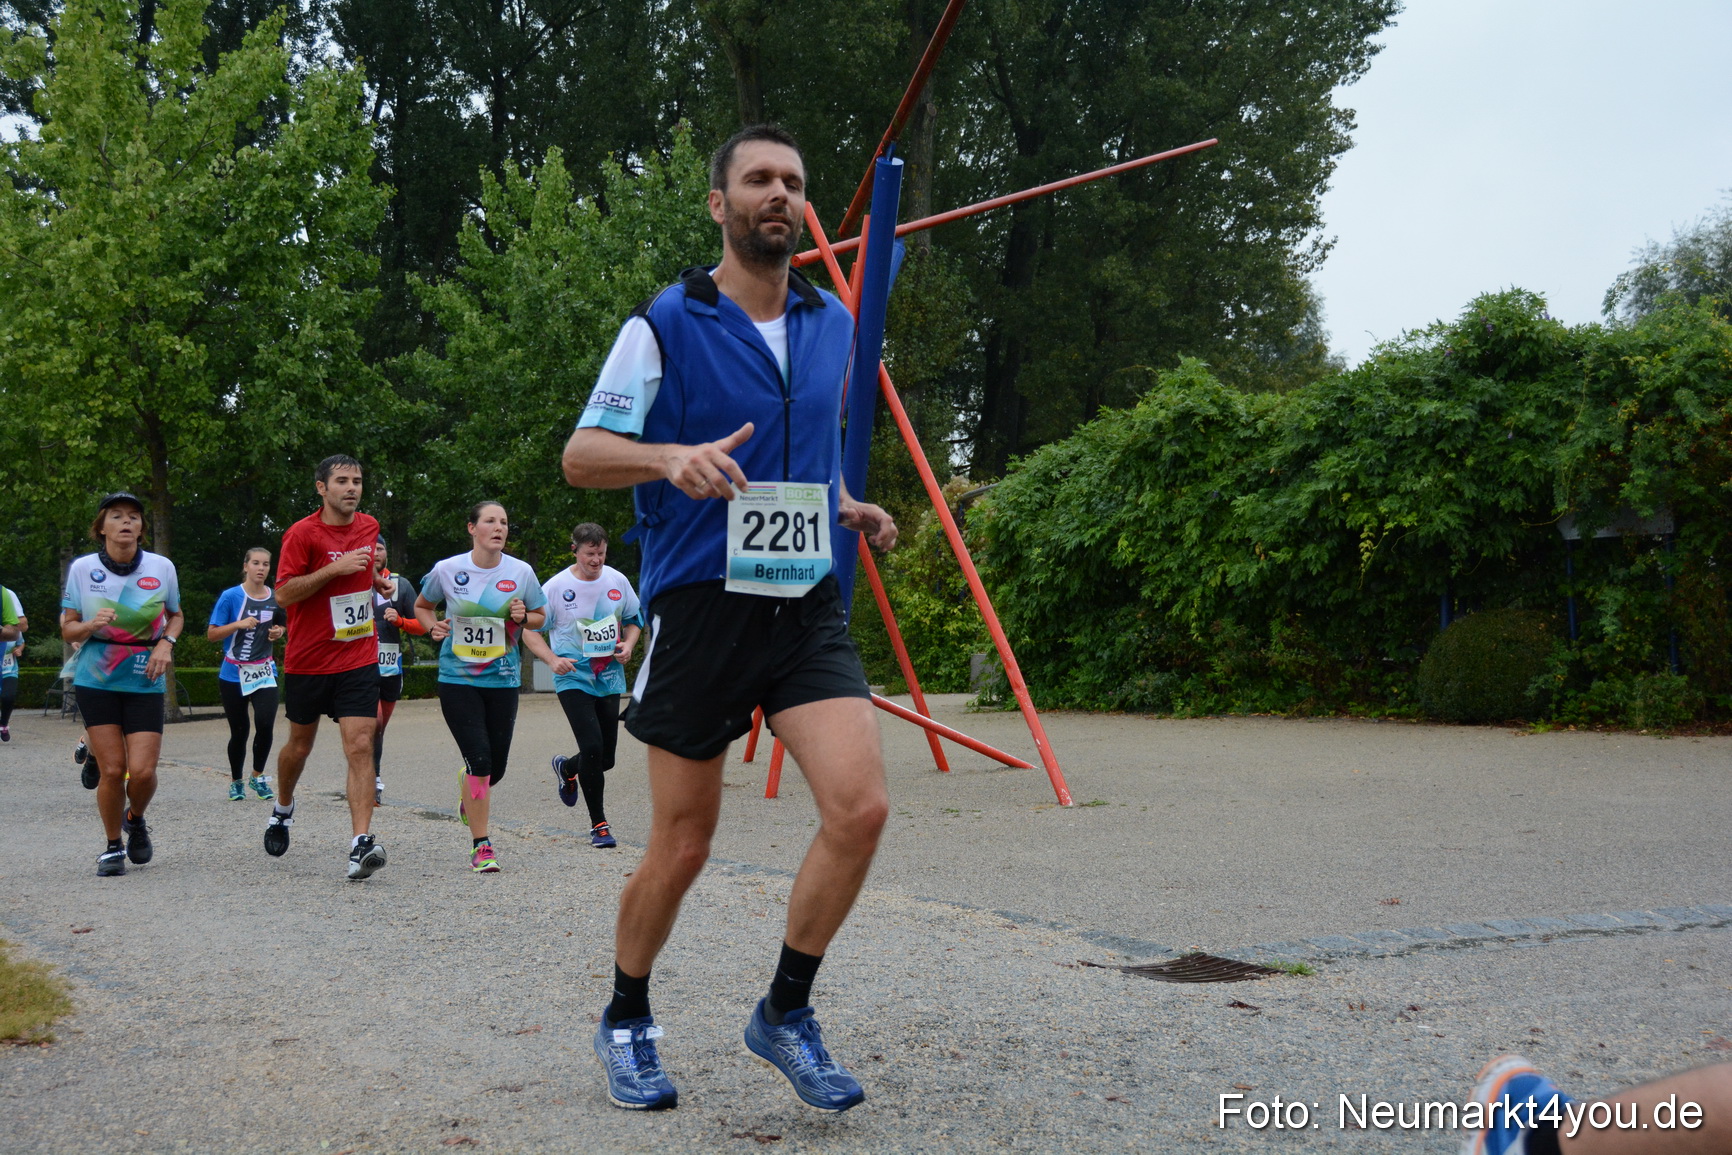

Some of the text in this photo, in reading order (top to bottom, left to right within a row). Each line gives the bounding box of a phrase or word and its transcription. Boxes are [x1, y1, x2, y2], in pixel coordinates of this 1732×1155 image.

[785, 487, 823, 501] BOCK
[742, 510, 820, 552] 2281
[755, 564, 815, 580] Bernhard
[463, 627, 493, 644] 341
[584, 624, 616, 642] 2555
[135, 655, 148, 664] 17.
[379, 651, 397, 665] 039
[471, 648, 487, 657] Nora
